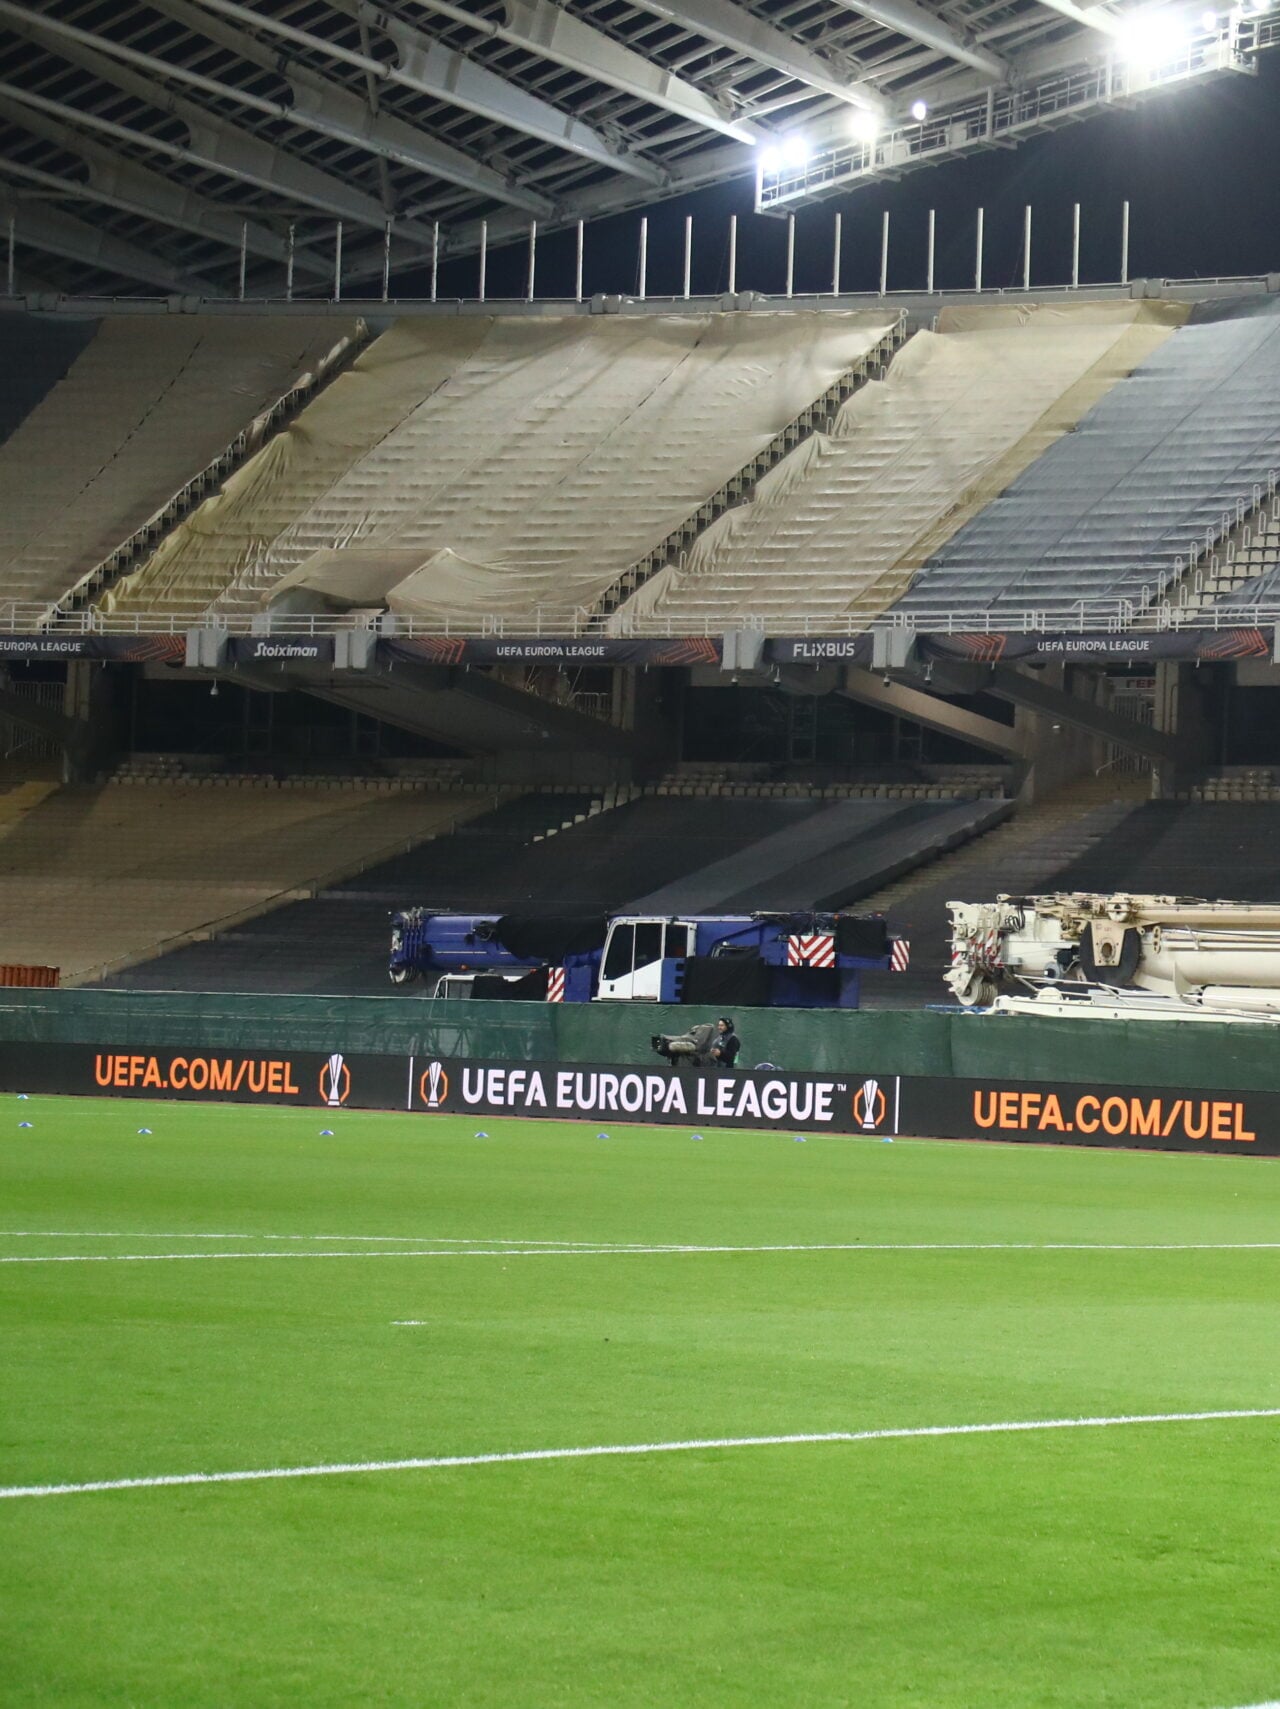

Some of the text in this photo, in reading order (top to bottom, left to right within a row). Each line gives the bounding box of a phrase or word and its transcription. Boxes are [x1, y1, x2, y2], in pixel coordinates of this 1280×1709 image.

[253, 642, 318, 657] Stoiximan
[496, 646, 523, 656] UEFA
[524, 646, 564, 657] EUROPA
[1037, 641, 1064, 652] UEFA
[1066, 640, 1107, 651] EUROPA
[94, 1053, 299, 1095] UEFA.COM/UEL
[462, 1067, 548, 1107] UEFA
[556, 1071, 688, 1114] EUROPA
[973, 1090, 1256, 1142] UEFA.COM/UEL
